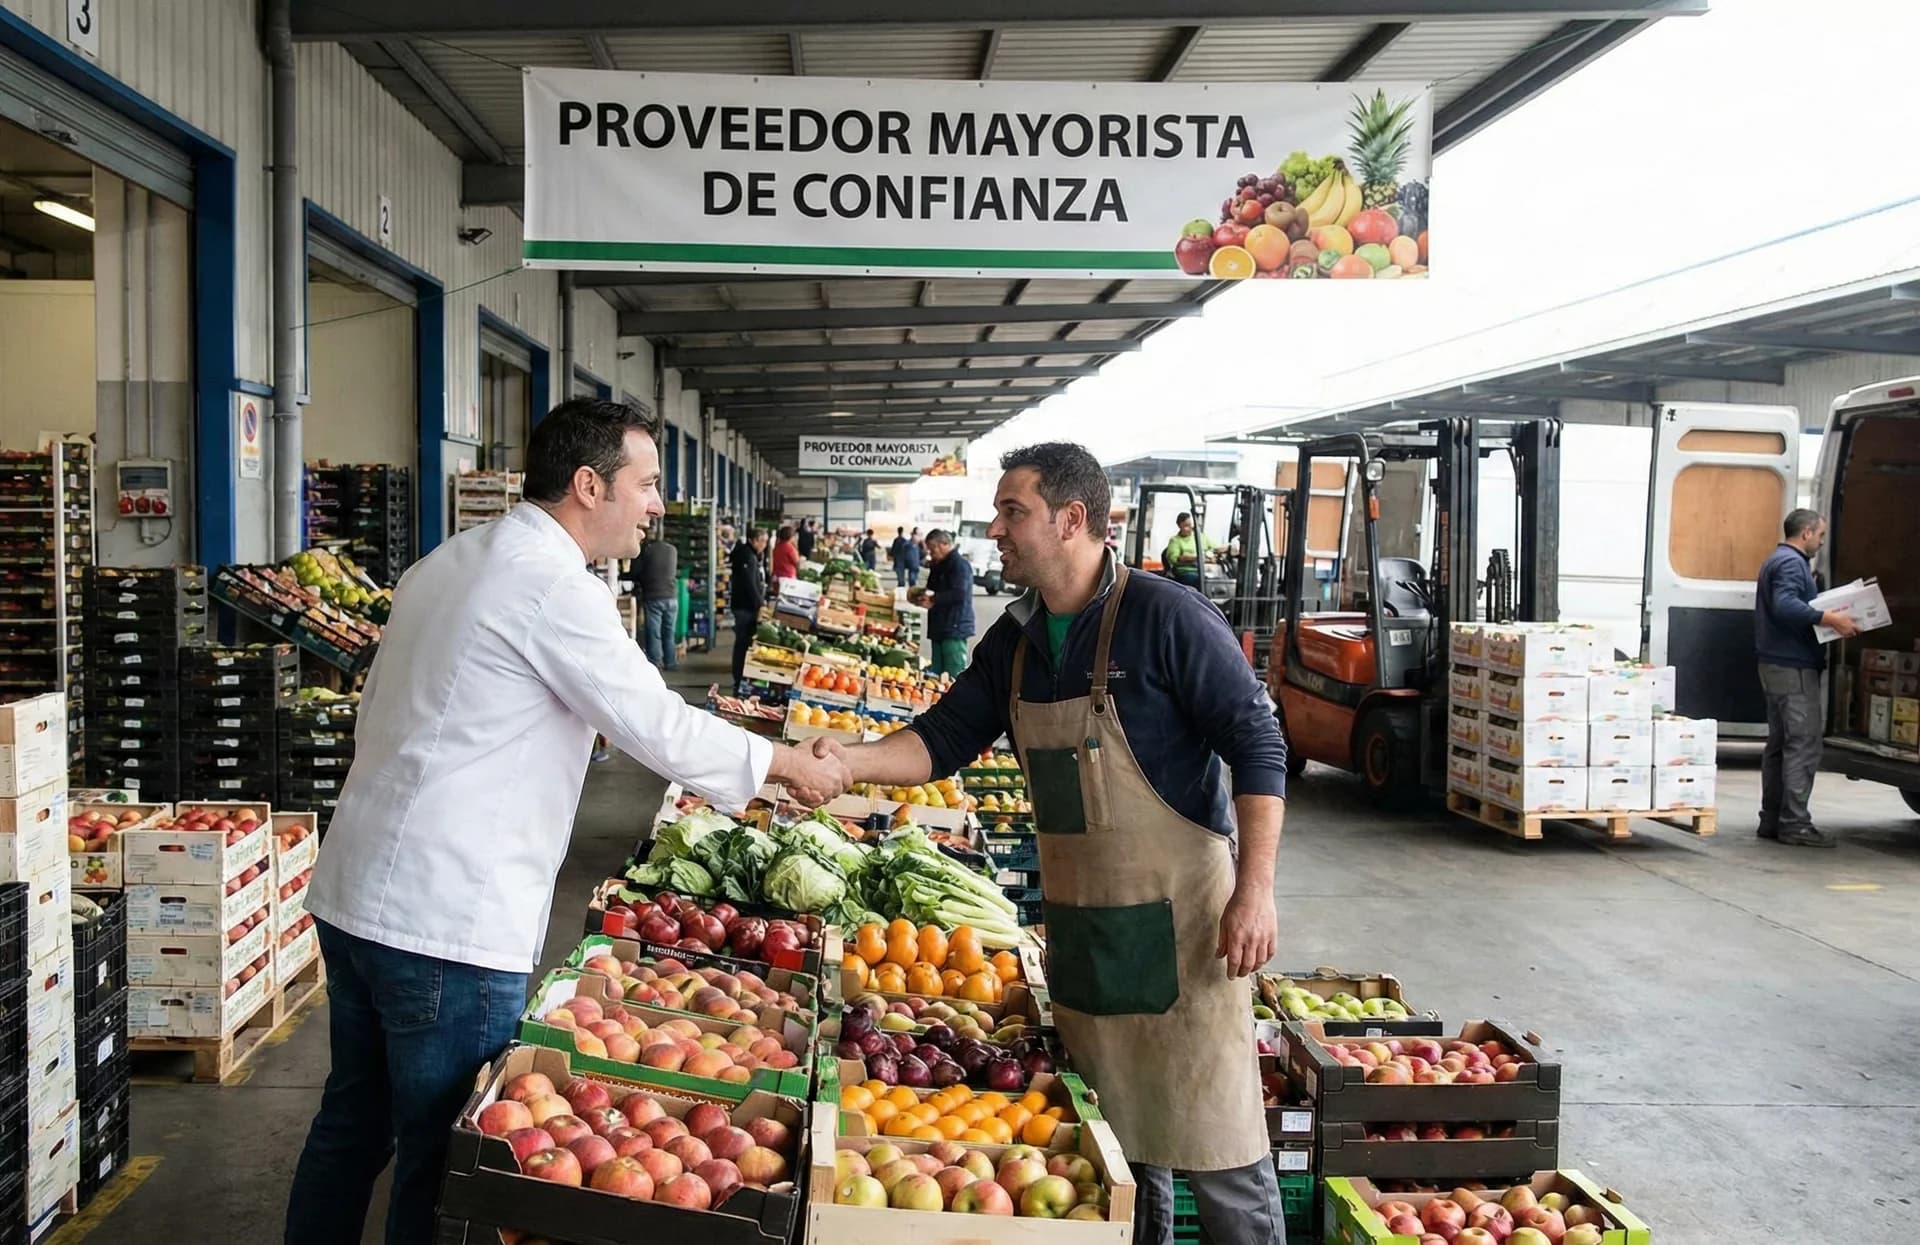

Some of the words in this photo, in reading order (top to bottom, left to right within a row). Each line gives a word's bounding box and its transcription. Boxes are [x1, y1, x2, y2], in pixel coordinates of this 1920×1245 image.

[559, 101, 912, 155] PROVEEDOR
[928, 111, 1255, 159] MAYORISTA
[703, 170, 777, 217] DE
[792, 172, 1129, 222] CONFIANZA
[382, 204, 389, 235] 2
[804, 441, 873, 454] PROVEEDOR
[875, 442, 940, 454] MAYORISTA
[830, 454, 845, 466] DE
[848, 454, 913, 467] CONFIANZA
